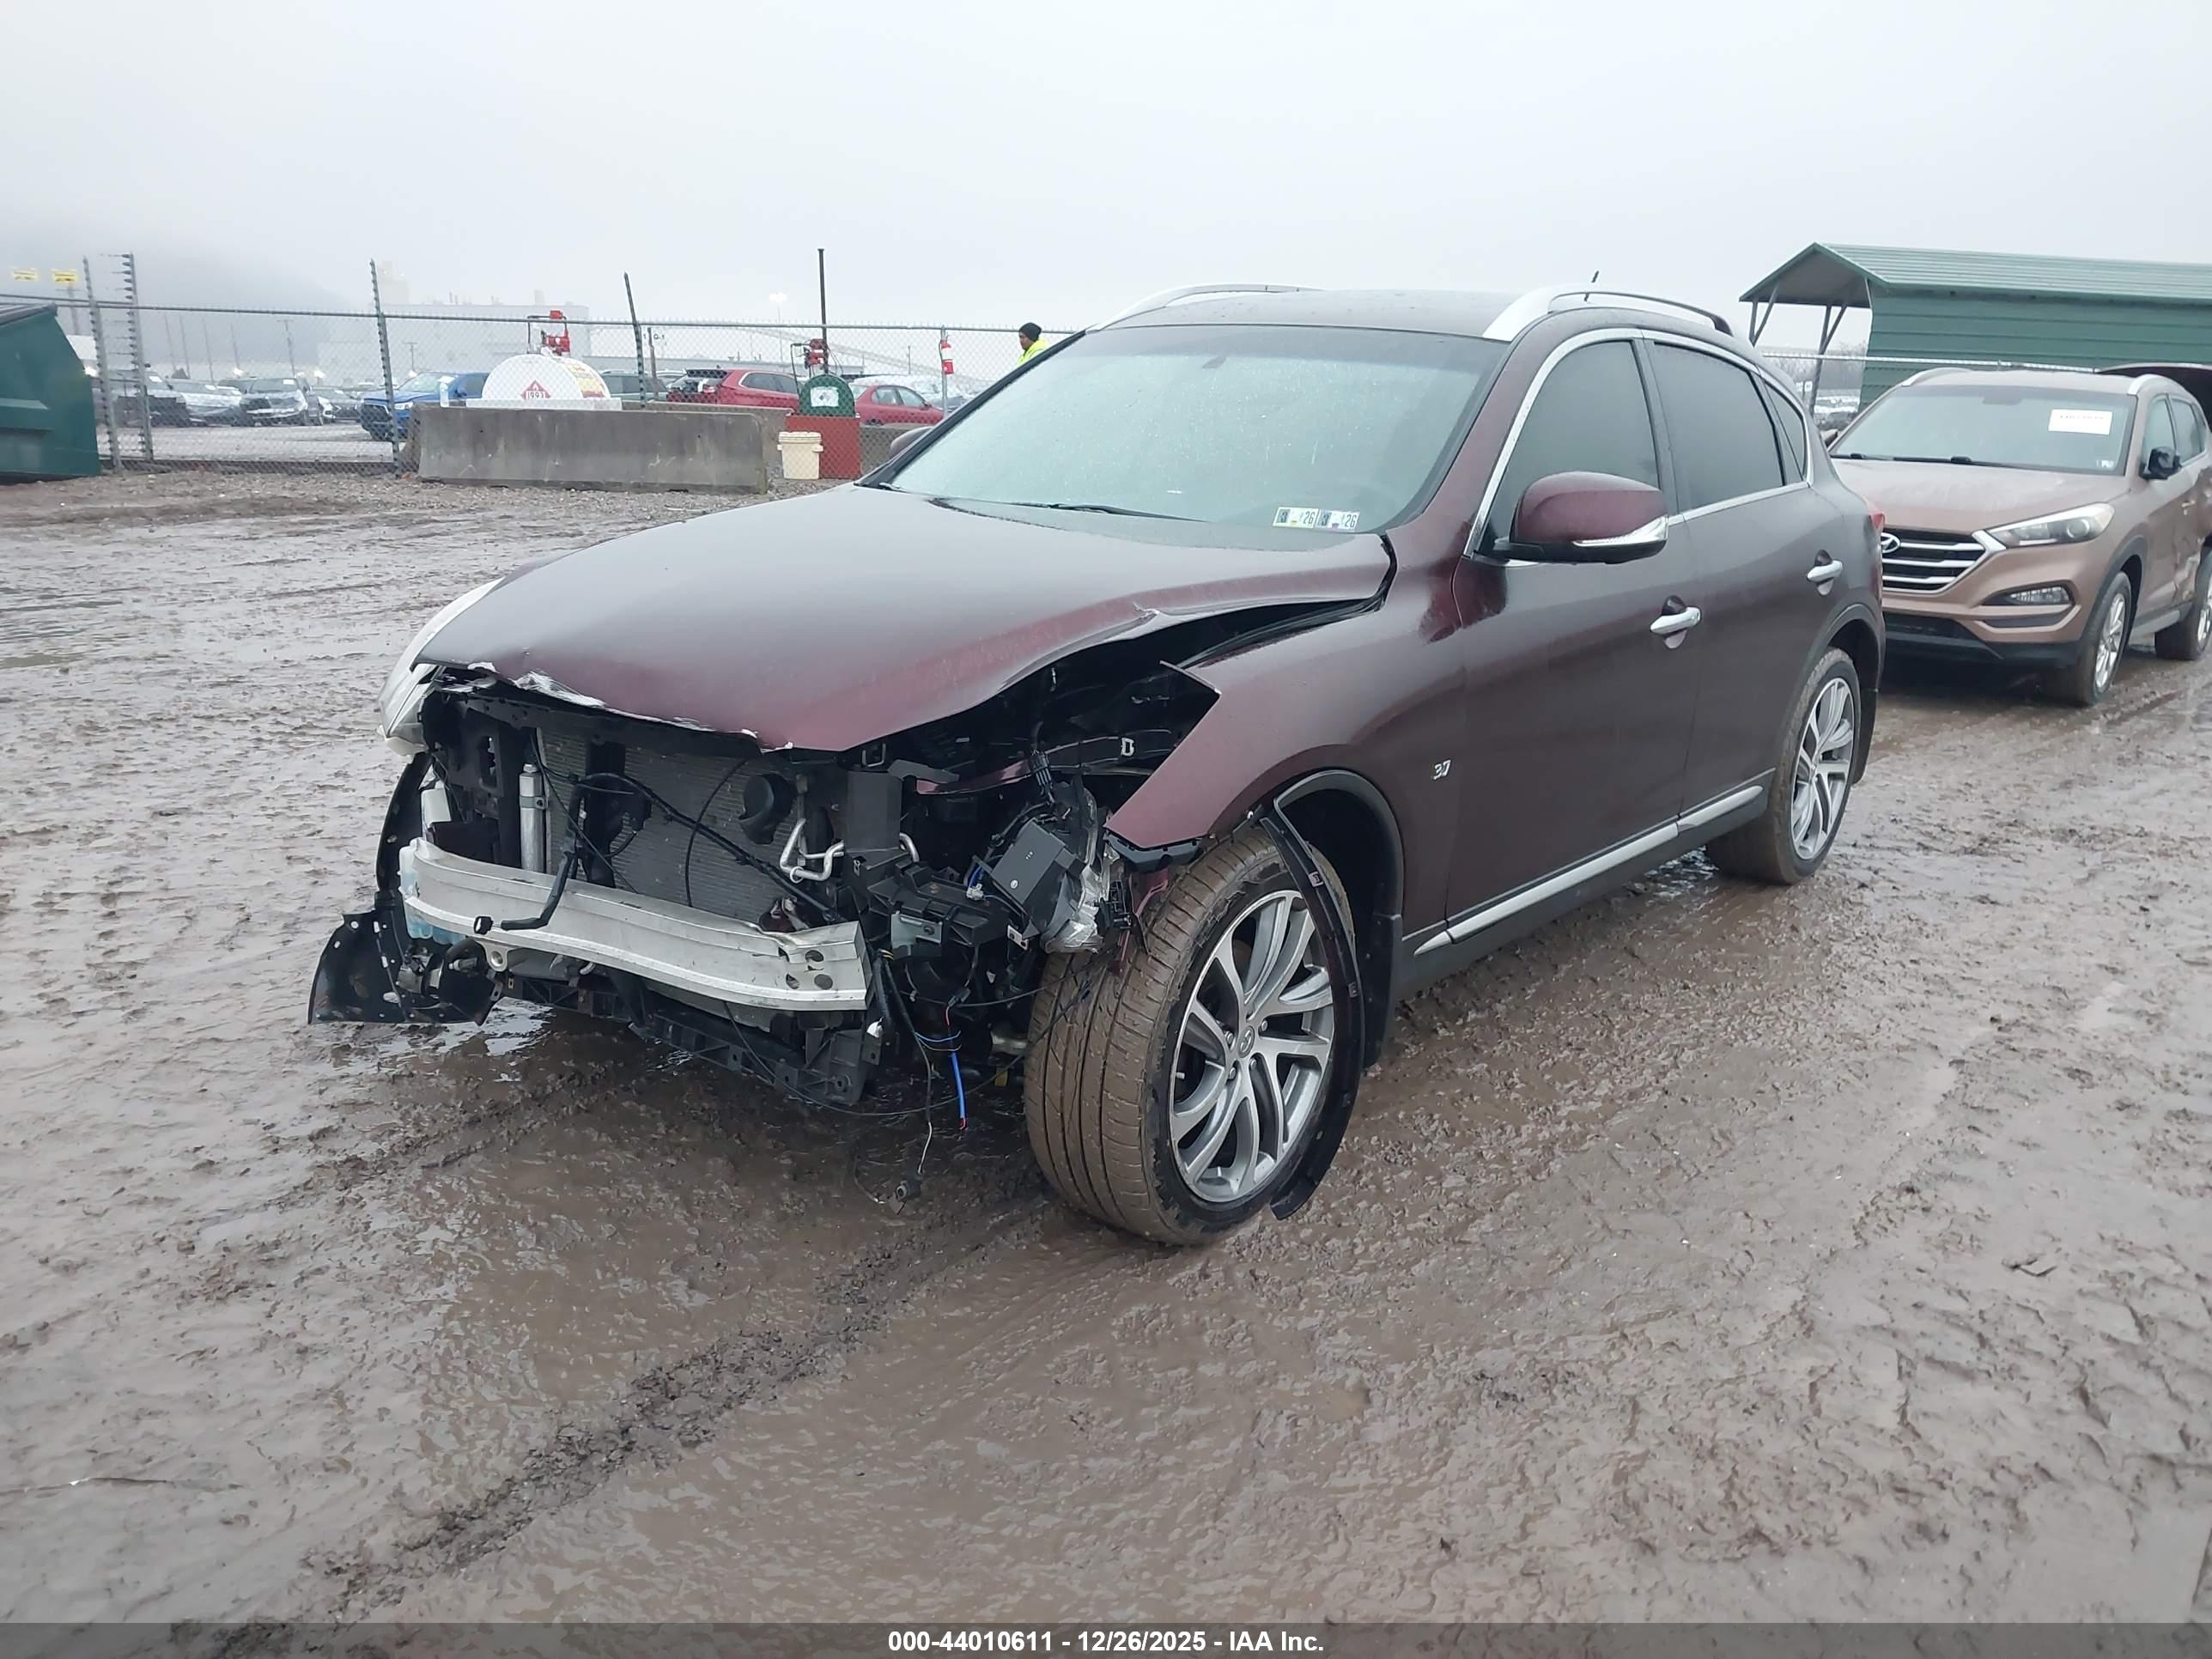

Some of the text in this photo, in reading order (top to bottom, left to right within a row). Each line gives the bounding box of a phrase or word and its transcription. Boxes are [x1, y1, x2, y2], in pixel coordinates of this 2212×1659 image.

[1303, 510, 1316, 525] 26
[1345, 514, 1357, 528] 26
[1432, 759, 1452, 781] 37
